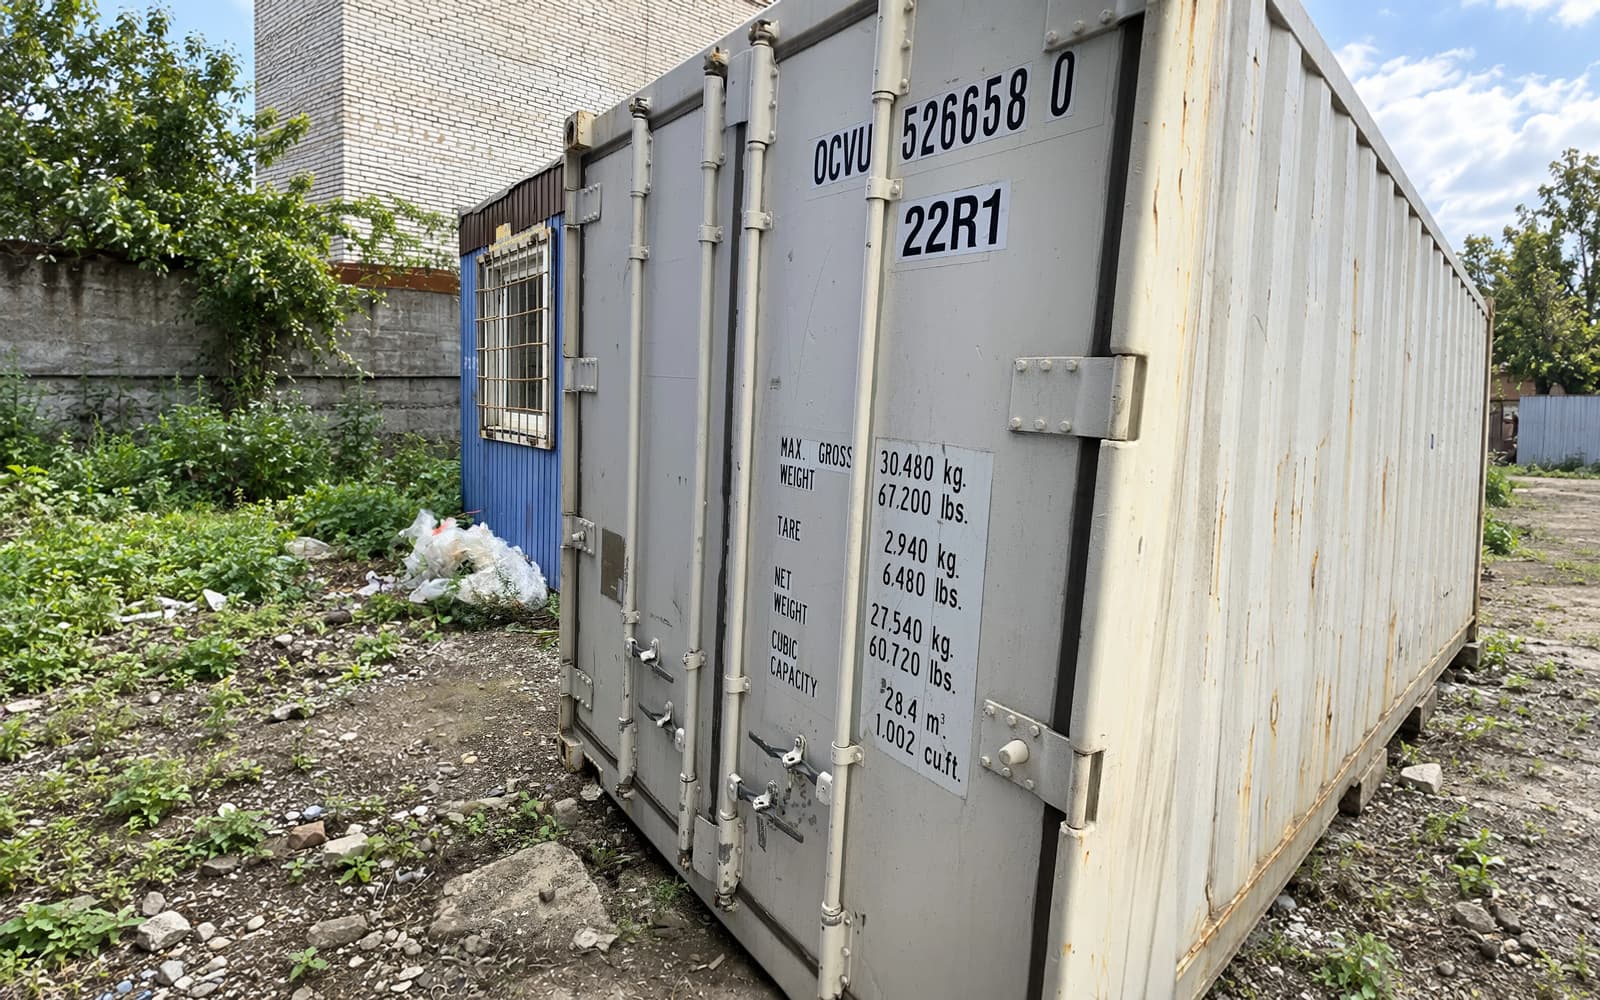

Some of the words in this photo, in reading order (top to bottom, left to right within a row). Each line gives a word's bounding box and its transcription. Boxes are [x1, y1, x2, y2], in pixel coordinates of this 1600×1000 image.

[814, 123, 872, 185] OCVU
[902, 67, 1028, 161] 526658
[1050, 51, 1074, 117] 0
[902, 188, 1002, 257] 22R1
[780, 436, 805, 461] MAX.
[819, 442, 852, 468] GROSS
[780, 463, 815, 490] WEIGHT
[943, 458, 966, 493] kg.
[941, 493, 968, 524] lbs.
[777, 515, 801, 541] TARE
[774, 566, 792, 590] NET
[937, 543, 959, 579] kg.
[774, 592, 808, 625] WEIGHT
[935, 577, 962, 610] lbs.
[771, 630, 798, 660] CUBIC
[932, 625, 953, 662] kg.
[770, 656, 817, 698] CAPACITY
[929, 659, 955, 694] lbs.
[885, 686, 917, 723] 28.4
